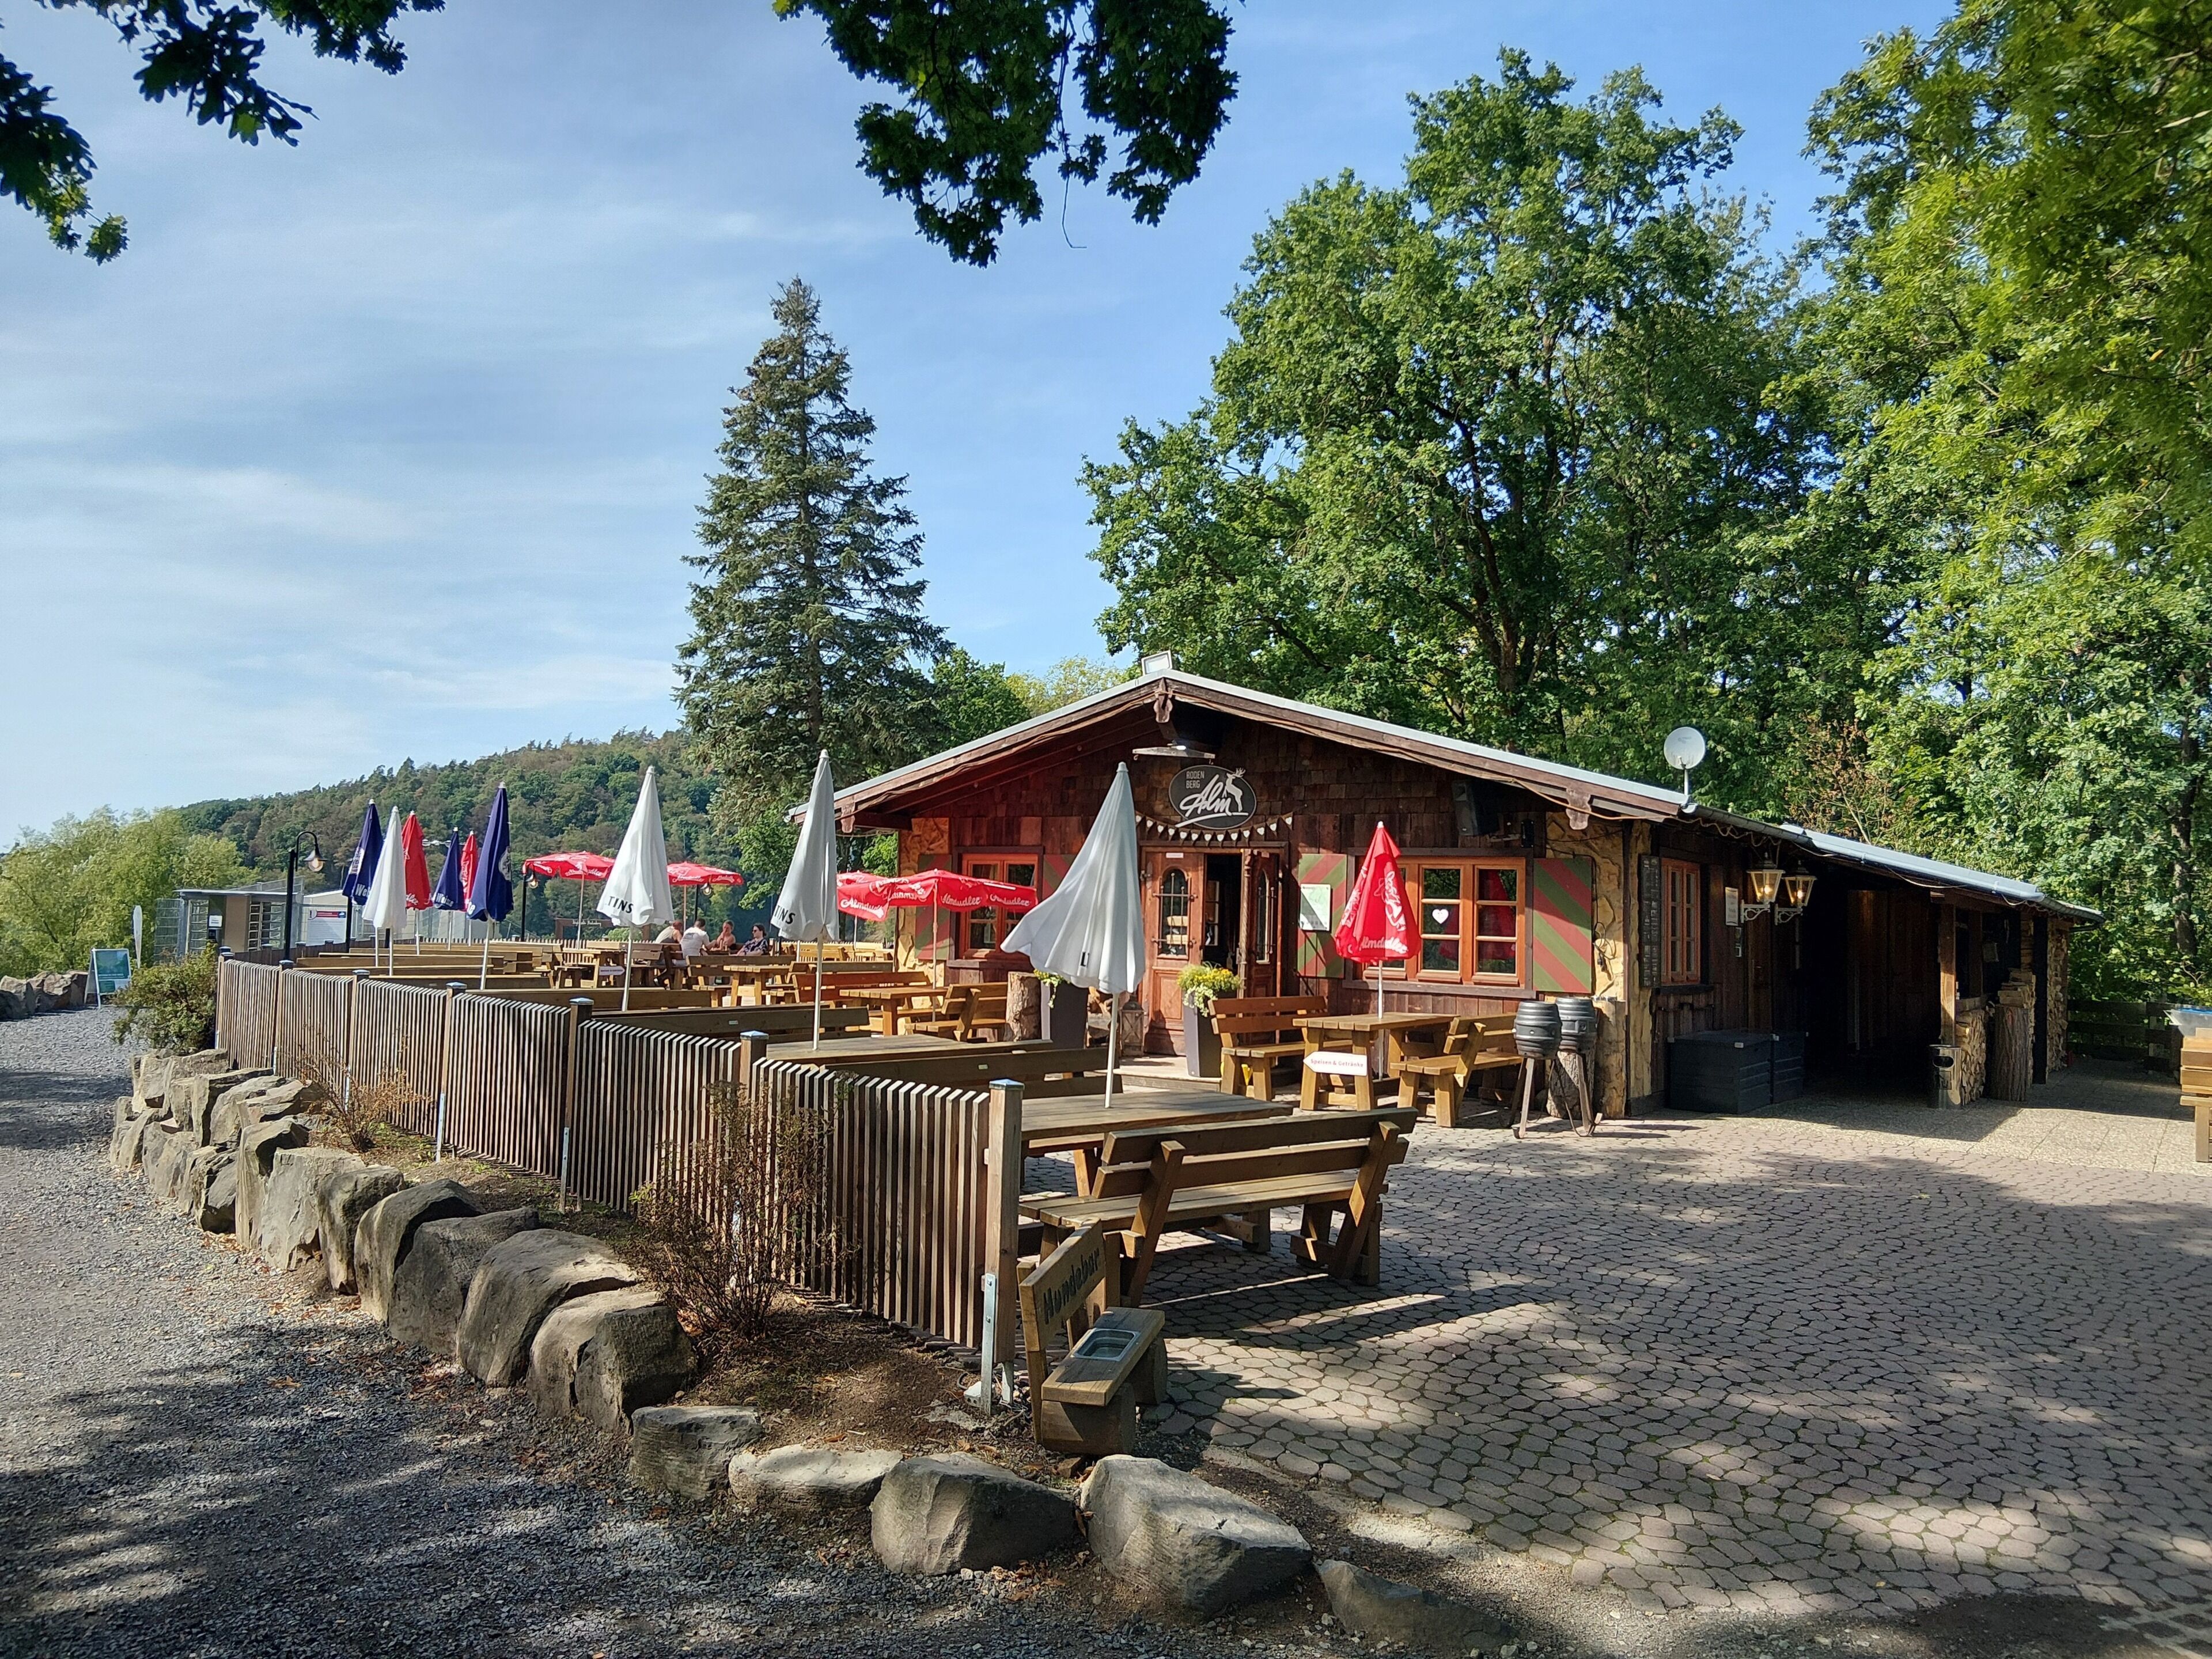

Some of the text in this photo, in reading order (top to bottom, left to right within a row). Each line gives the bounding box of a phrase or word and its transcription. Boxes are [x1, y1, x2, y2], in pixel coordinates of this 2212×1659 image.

[1185, 780, 1200, 789] BERG
[1186, 771, 1205, 779] RODEN
[1179, 774, 1232, 817] Alm
[1043, 1247, 1100, 1325] Hundebar
